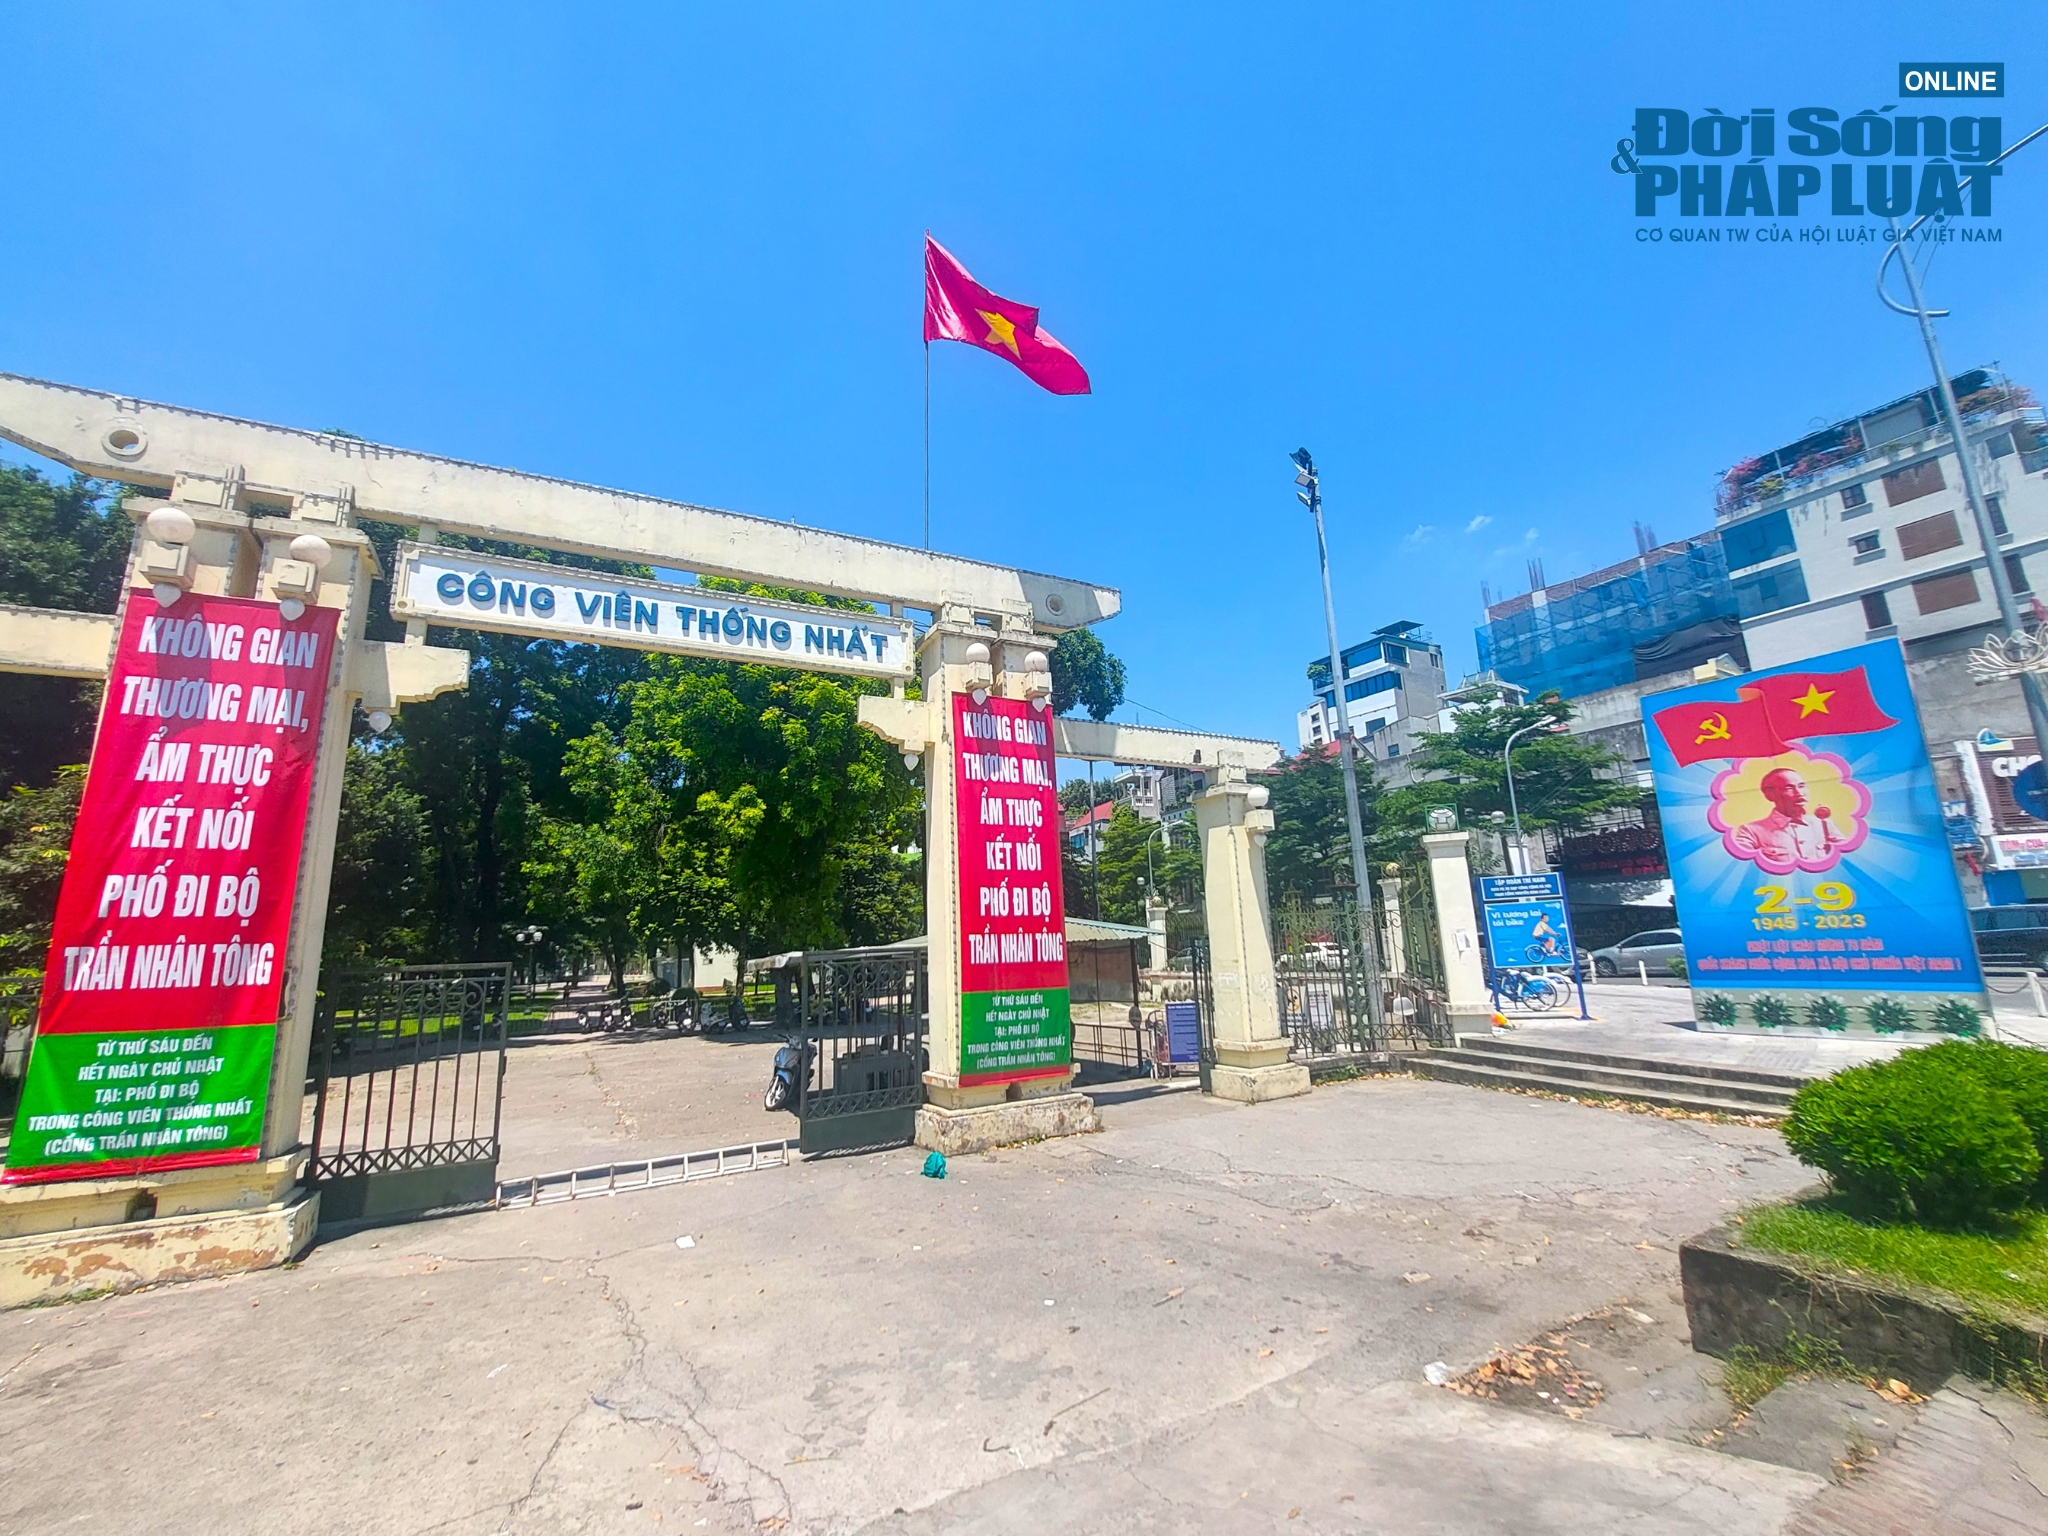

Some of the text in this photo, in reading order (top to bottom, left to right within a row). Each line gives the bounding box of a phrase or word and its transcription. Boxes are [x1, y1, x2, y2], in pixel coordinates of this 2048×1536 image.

[437, 570, 888, 657] CÔNG VIÊN THỐNG NHẤT
[137, 612, 319, 668] KHÔNG GIAN
[120, 675, 309, 734] THƯƠNG MẠI,
[962, 708, 1047, 746] KHÔNG GIAN
[135, 725, 274, 794] ẨM THỰC
[962, 752, 1053, 792] THƯƠNG MẠI,
[130, 794, 255, 850] KẾT NỐI
[980, 786, 1043, 833] ẨM THỰC
[985, 832, 1042, 871] KẾT NỐI
[98, 859, 260, 927] PHỐ ĐI BỘ
[980, 877, 1052, 922] PHỐ ĐI BỘ
[1752, 917, 1798, 931] 1945
[1814, 914, 1867, 929] 2023
[63, 930, 275, 991] TRẦN NHÂN TÔNG
[968, 923, 1064, 965] TRẦN NHÂN TÔNG
[97, 1032, 213, 1057] TỪ THỨ SÁU ĐẾN
[967, 1043, 989, 1055] TRONG
[1010, 1038, 1025, 1050] VIÊN
[78, 1055, 225, 1081] HẾT NGÀY CHỦ NHẬT
[28, 1096, 254, 1131] TRONG CÔNG VIÊN THỐNG NHẤT
[95, 1080, 200, 1106] TẠI: PHỐ ĐI BỘ
[141, 1126, 184, 1147] NHÂN
[185, 1124, 229, 1142] TÔNG)
